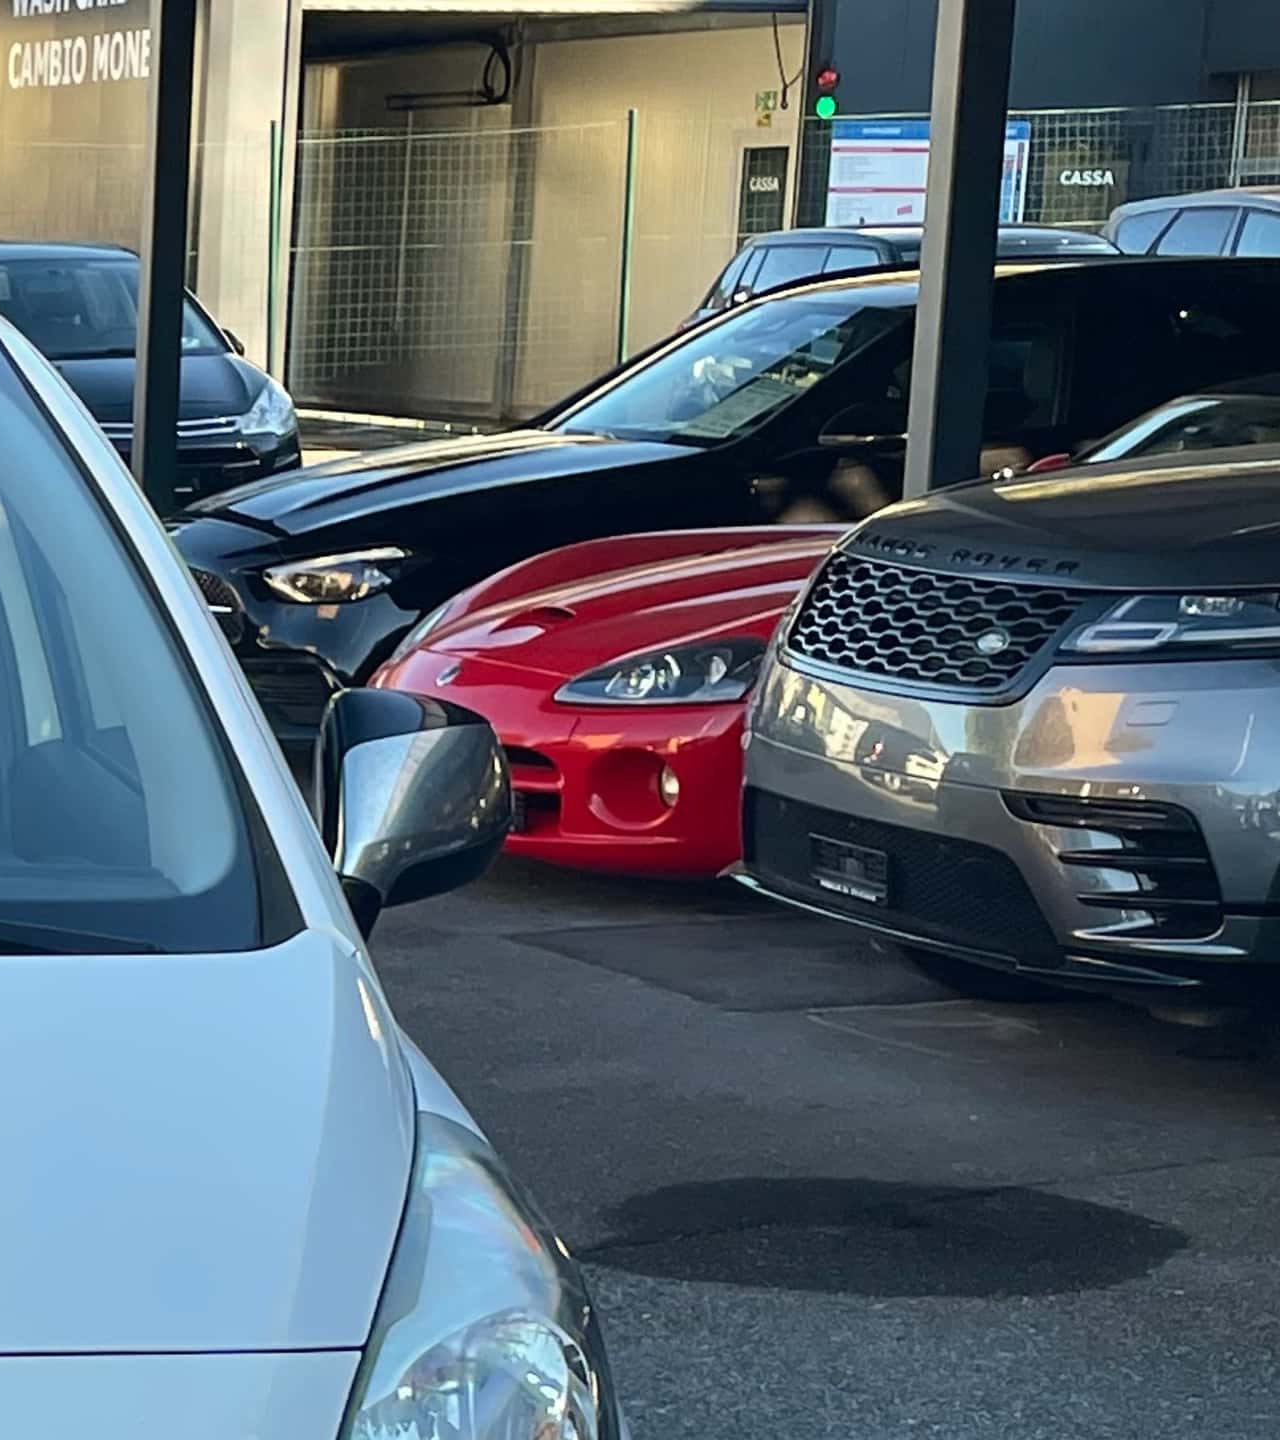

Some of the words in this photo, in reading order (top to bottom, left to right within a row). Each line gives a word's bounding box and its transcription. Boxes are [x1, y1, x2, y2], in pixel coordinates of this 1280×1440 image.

[8, 36, 87, 89] CAMBIO
[92, 29, 151, 82] MONE
[749, 176, 779, 192] CASSA
[1060, 169, 1114, 186] CASSA
